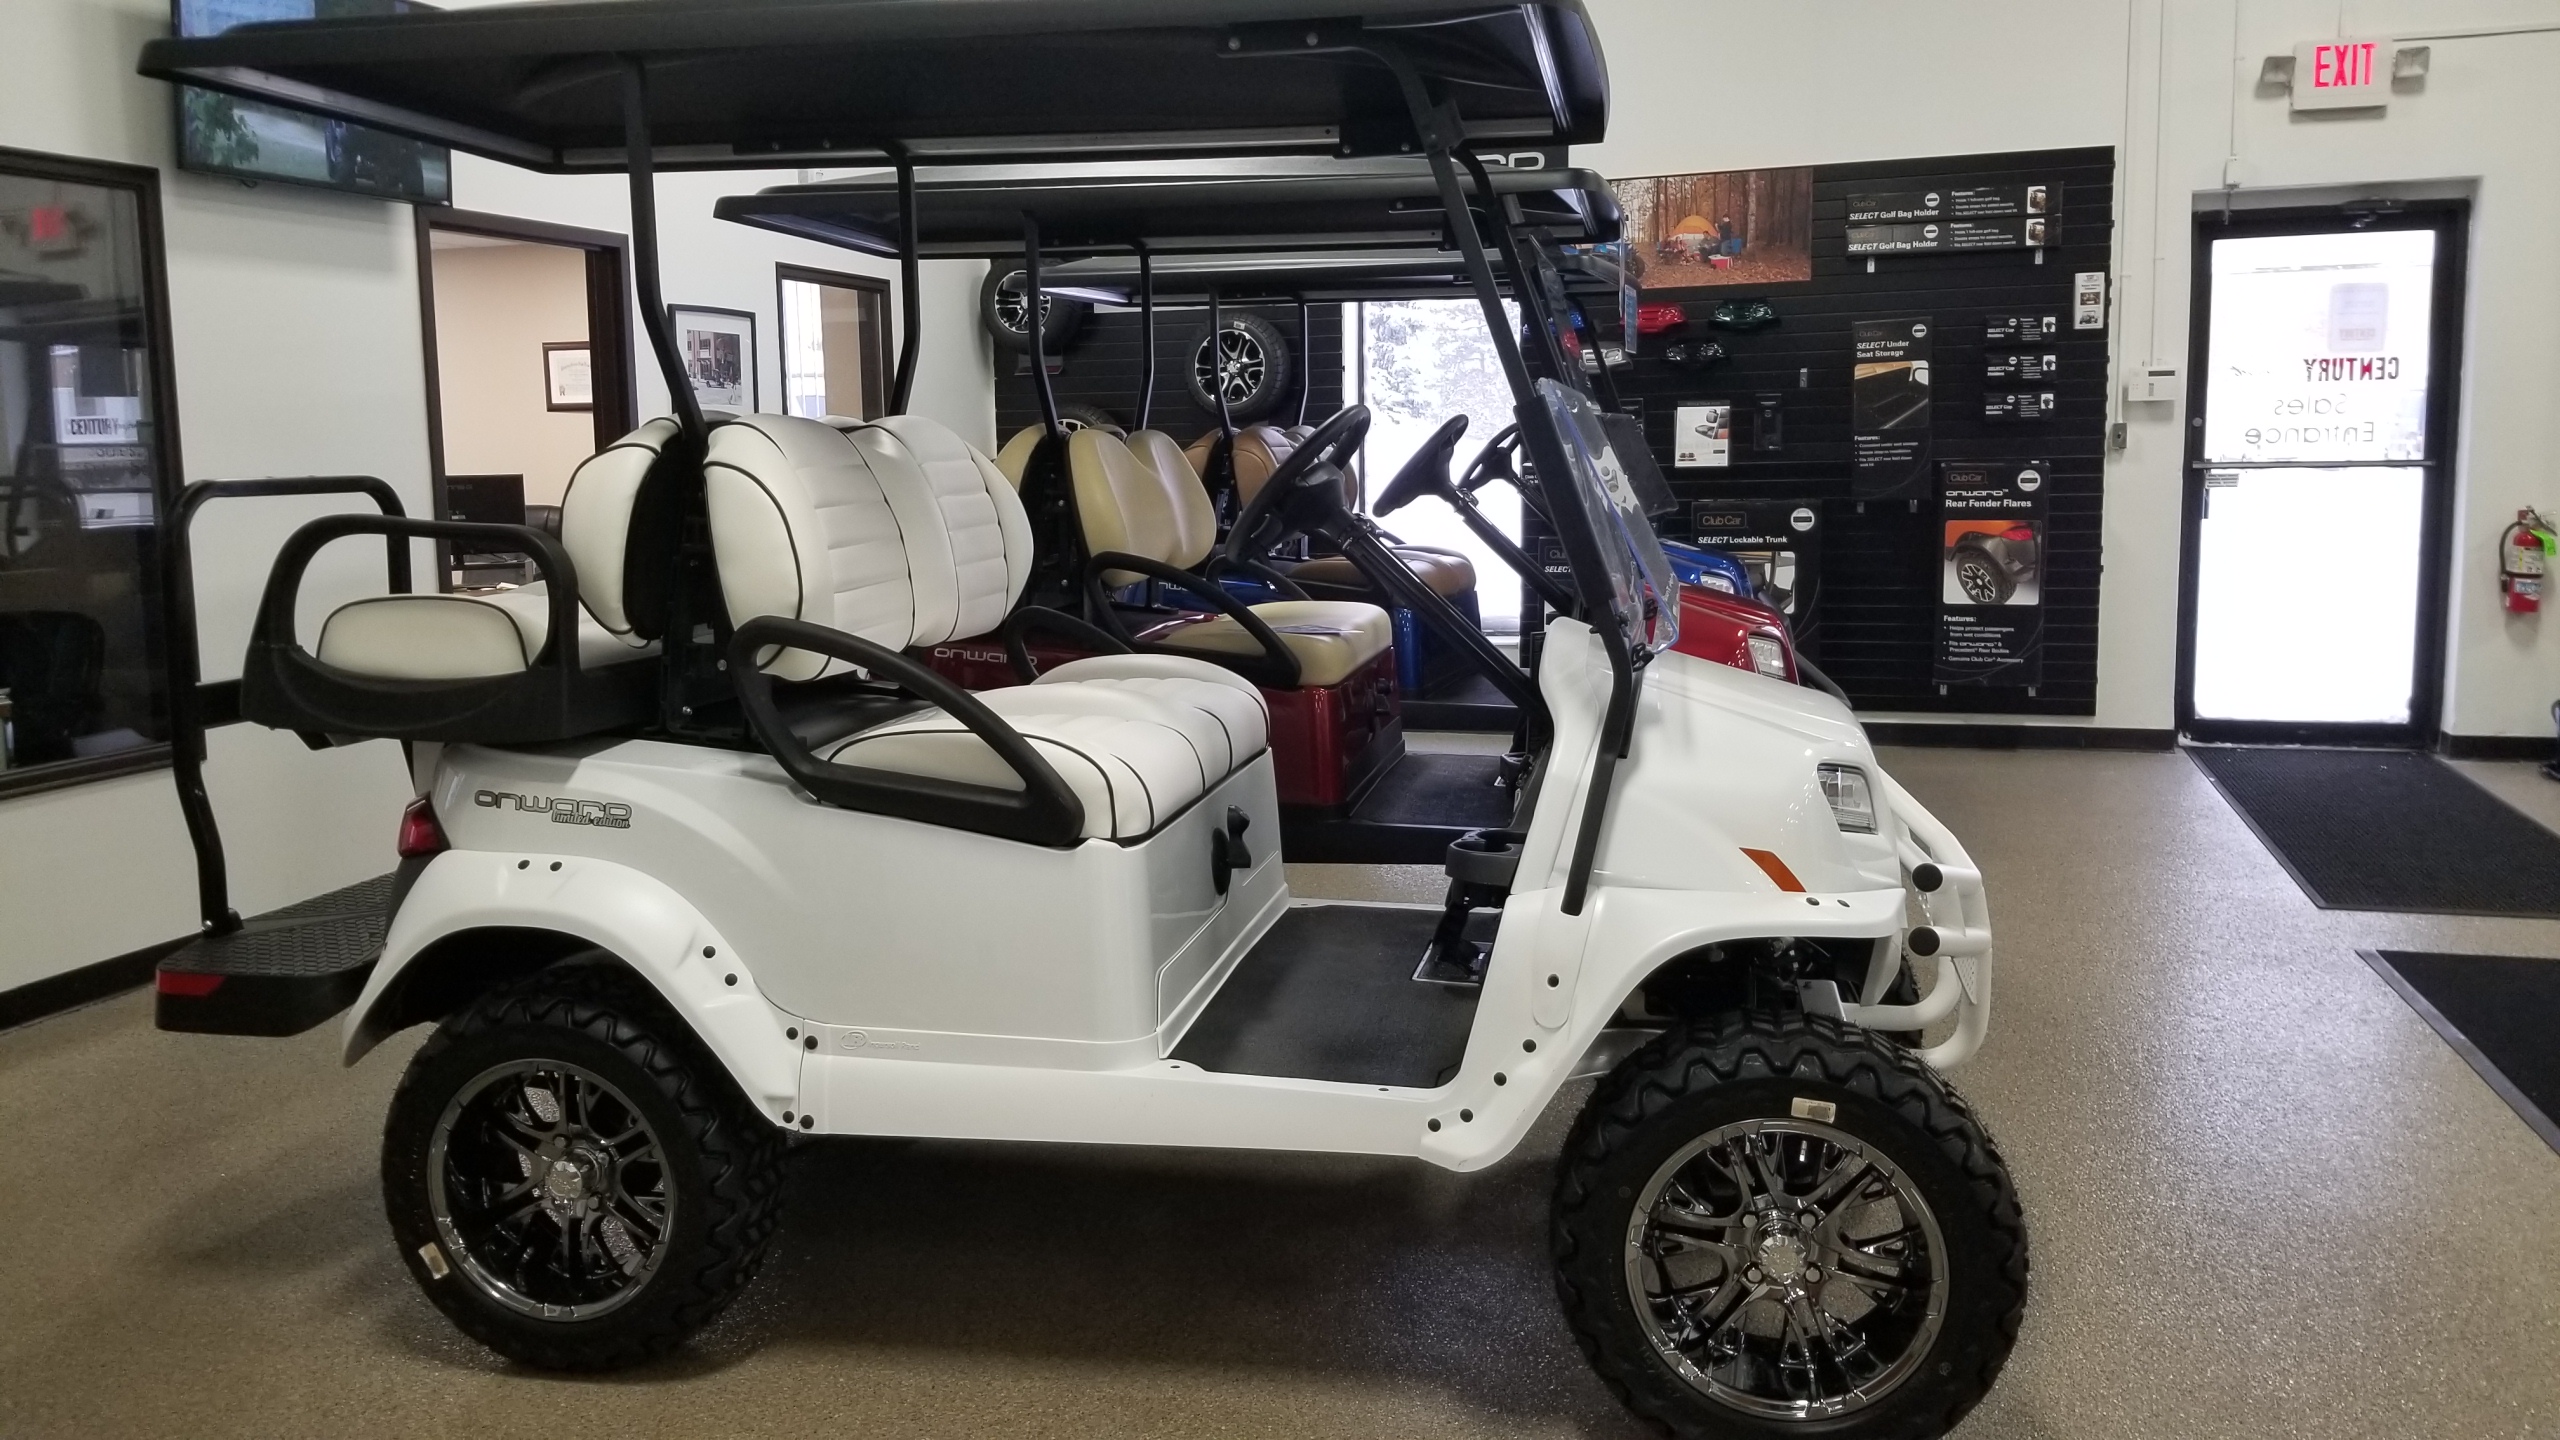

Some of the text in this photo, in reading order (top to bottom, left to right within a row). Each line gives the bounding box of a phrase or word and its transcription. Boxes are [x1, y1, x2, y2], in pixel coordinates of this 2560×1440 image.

[2314, 42, 2377, 88] EXIT
[1849, 212, 1879, 220] SELECT
[1880, 210, 1896, 218] Golf
[1897, 210, 1912, 218] Bag
[1848, 243, 1878, 251] SELECT
[1913, 240, 1938, 248] Holder
[1856, 341, 1886, 349] SELECT
[1945, 499, 2032, 507] Rear Fender Flares
[1703, 516, 1742, 525] Club Car
[1698, 536, 1728, 544] SELECT
[551, 810, 631, 829] limited edition
